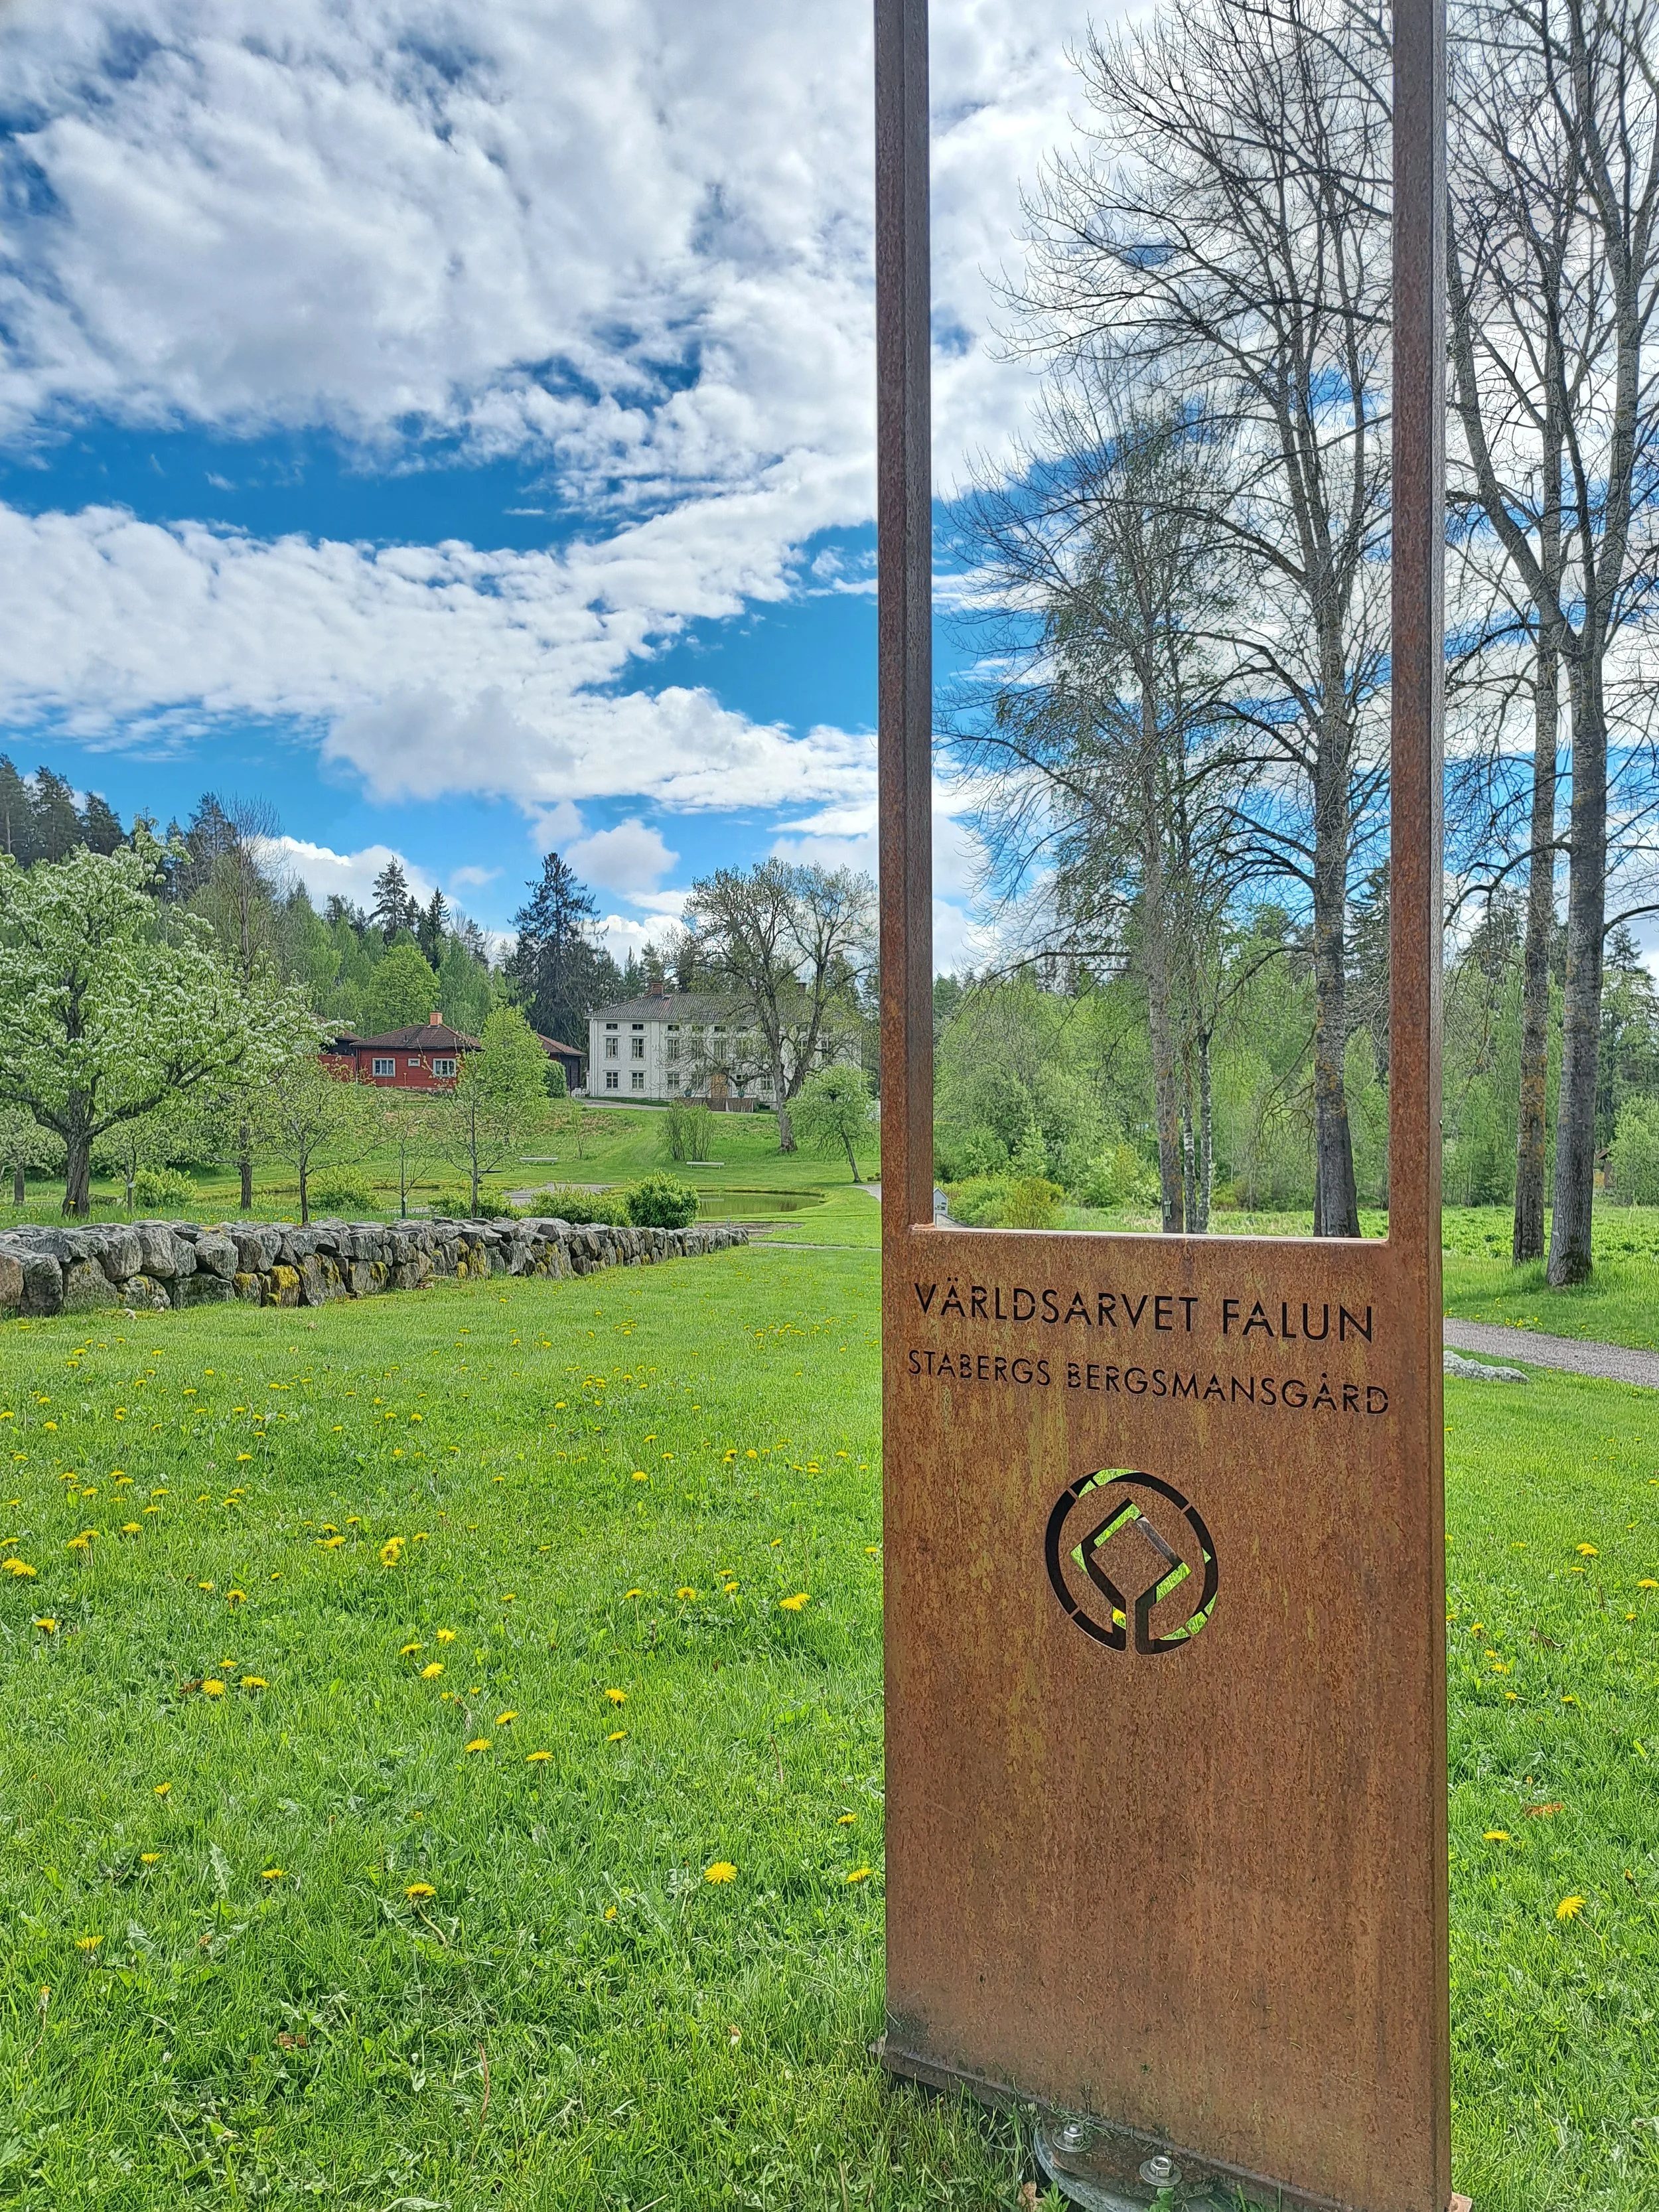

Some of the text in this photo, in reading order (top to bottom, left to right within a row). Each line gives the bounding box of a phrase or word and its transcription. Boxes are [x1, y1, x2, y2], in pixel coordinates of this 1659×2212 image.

[914, 1276, 1374, 1343] VÄRLDSARVET FALUN
[908, 1349, 1390, 1416] STABERGS BERGSMANSGÅRD
